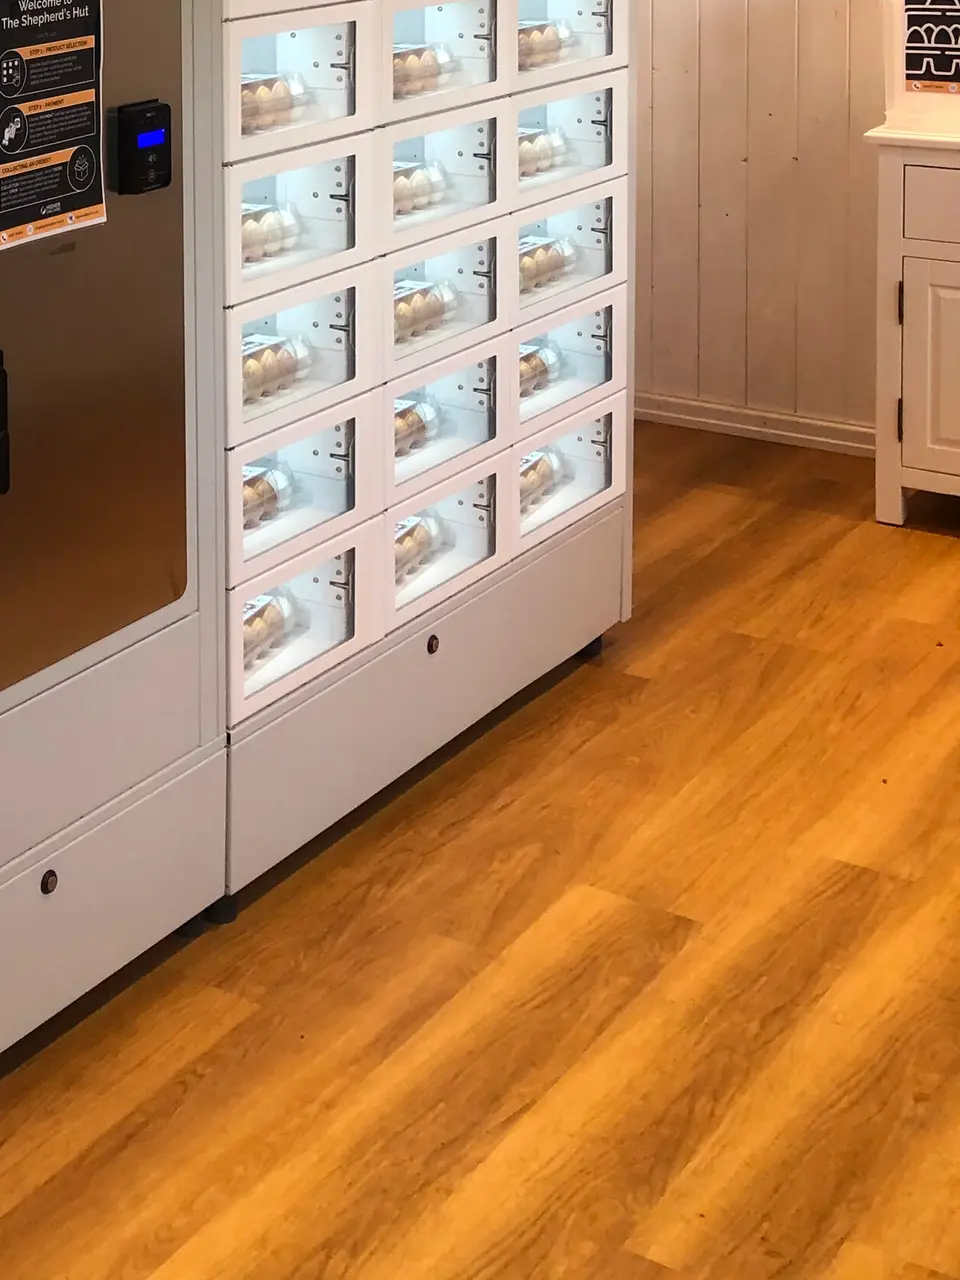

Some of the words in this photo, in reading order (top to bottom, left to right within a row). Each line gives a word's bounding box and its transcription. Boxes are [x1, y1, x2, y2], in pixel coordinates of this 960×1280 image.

[1, 17, 19, 29] The
[21, 8, 71, 27] Shepherd's
[72, 5, 89, 17] Hut
[45, 43, 66, 52] PRODUCT
[66, 40, 88, 49] SELECTION
[2, 162, 29, 174] COLLECTING
